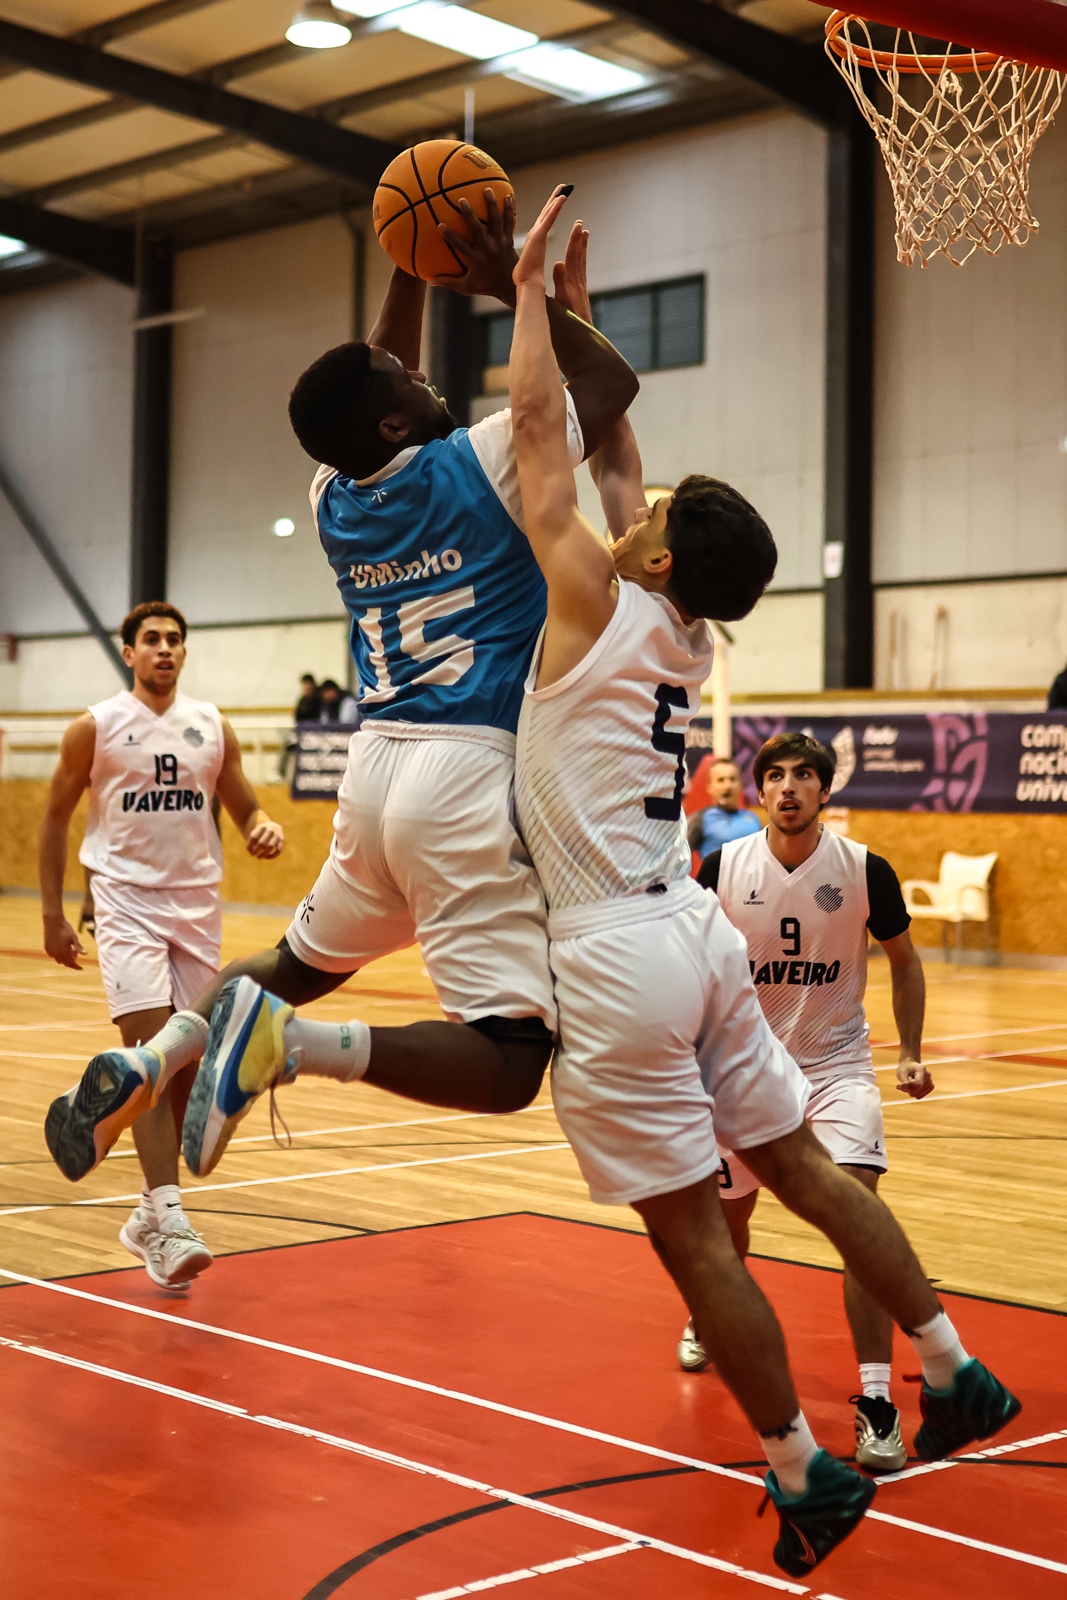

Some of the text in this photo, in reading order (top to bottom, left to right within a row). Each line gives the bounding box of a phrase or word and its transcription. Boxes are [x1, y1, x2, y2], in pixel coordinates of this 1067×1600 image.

[349, 548, 463, 590] UMinho
[357, 585, 476, 704] 15
[643, 682, 690, 822] 5
[1020, 724, 1067, 751] cam
[154, 753, 178, 786] 19
[1019, 751, 1067, 775] naci
[122, 789, 204, 813] UAVEIRO
[780, 917, 801, 956] 9
